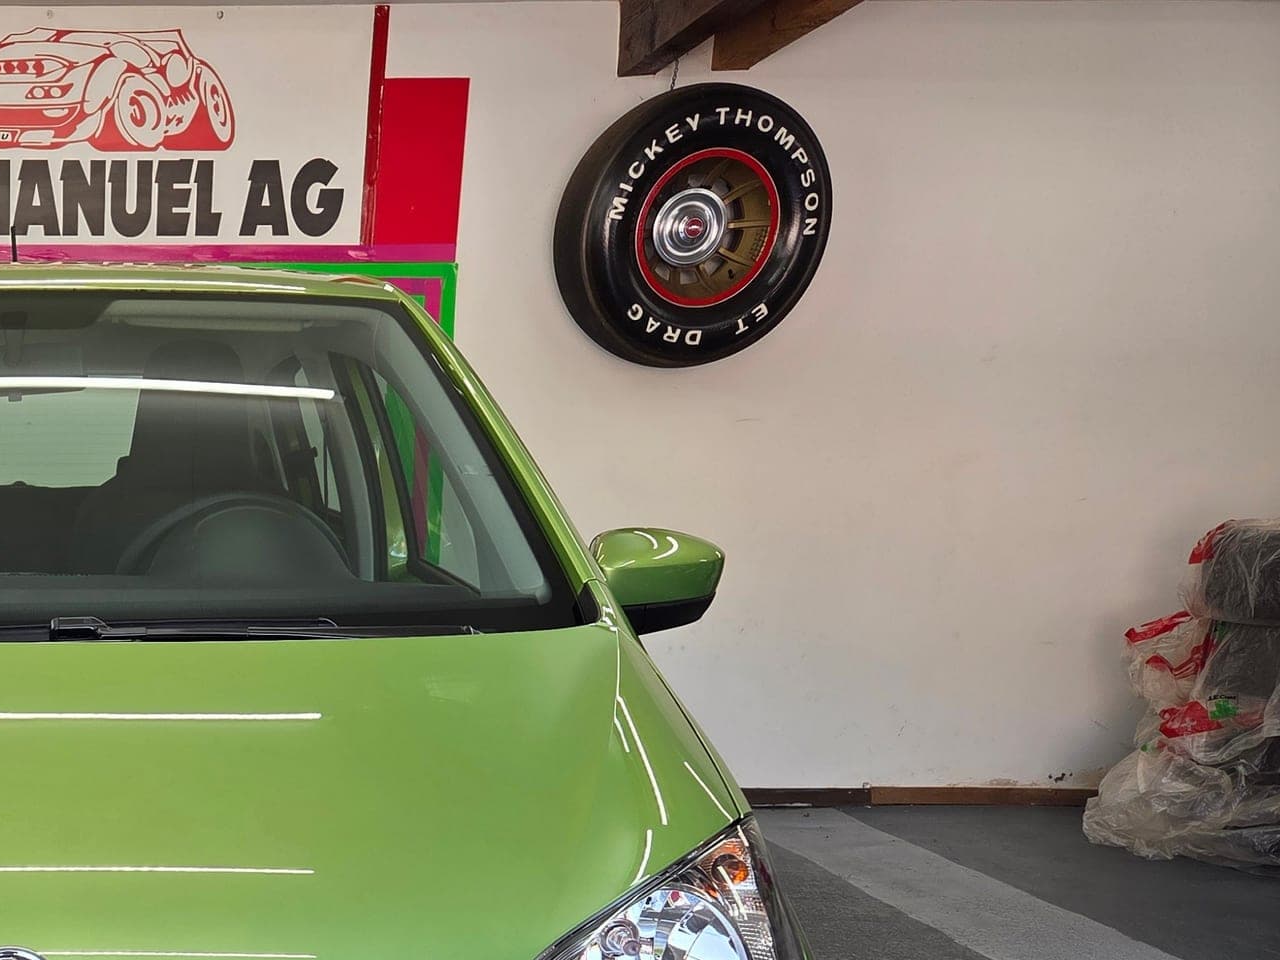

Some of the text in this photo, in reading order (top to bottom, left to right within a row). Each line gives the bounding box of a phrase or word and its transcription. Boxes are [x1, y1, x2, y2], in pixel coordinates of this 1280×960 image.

[238, 157, 345, 237] AG
[609, 107, 819, 236] MICKEY THOMPSON
[626, 303, 769, 346] ET DRAG
